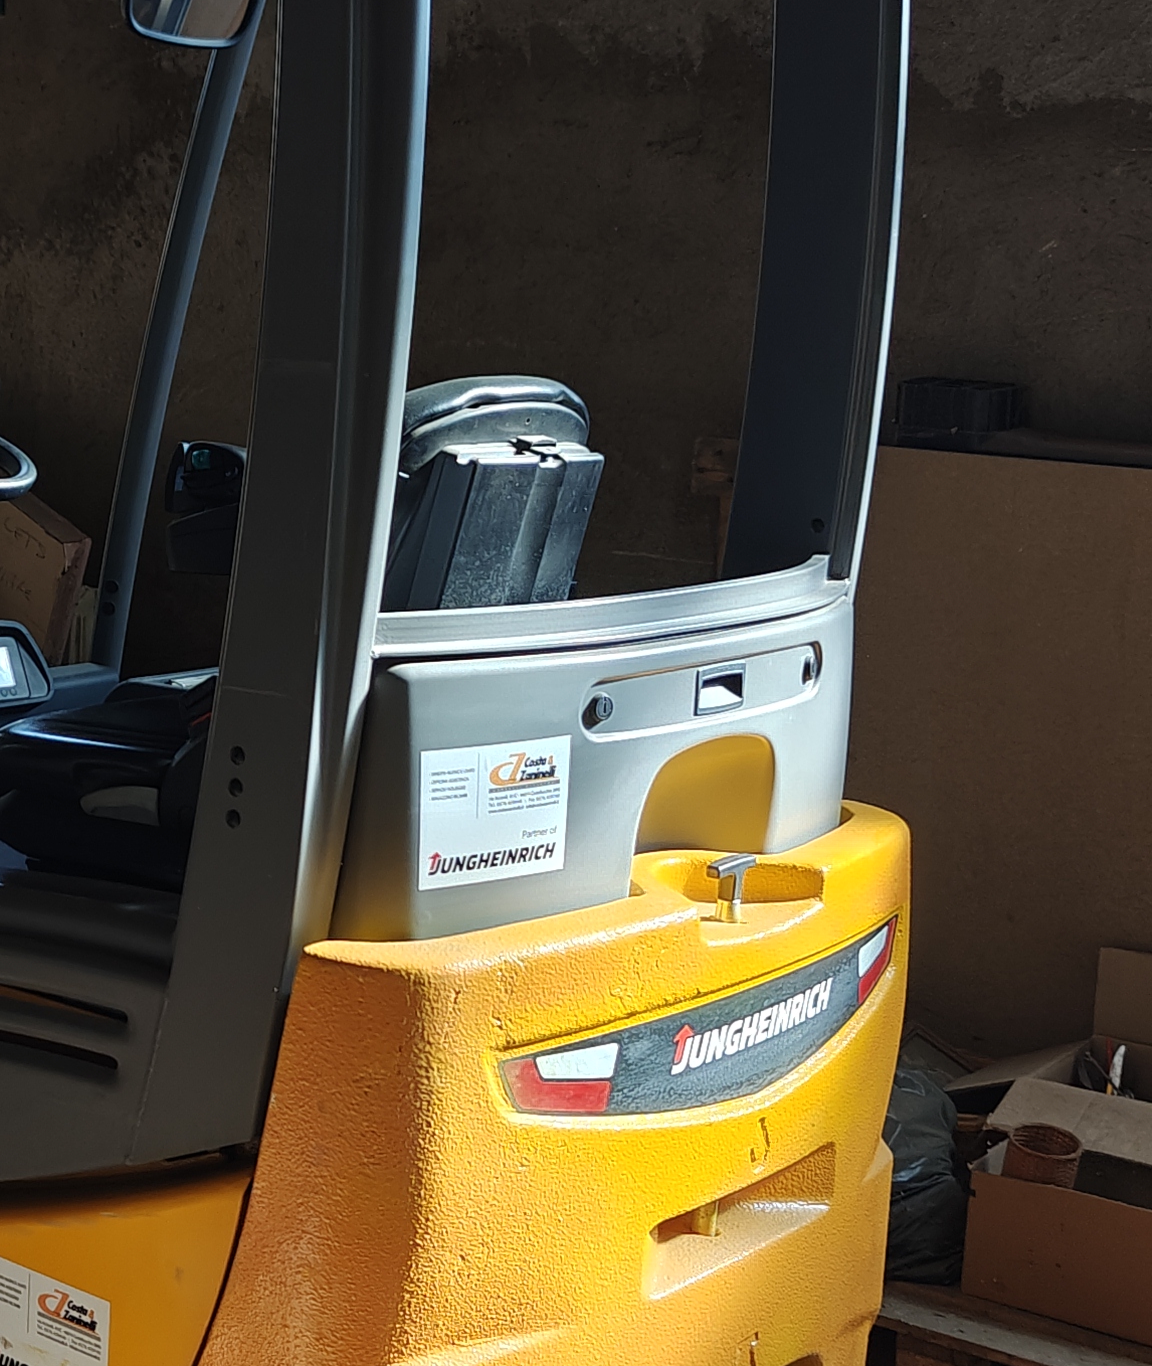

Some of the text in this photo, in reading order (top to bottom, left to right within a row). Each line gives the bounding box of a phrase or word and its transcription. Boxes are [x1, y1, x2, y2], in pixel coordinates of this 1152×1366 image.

[524, 756, 547, 768] Costa
[522, 828, 548, 839] Partner
[428, 842, 556, 876] JUNGHEINRICH
[670, 977, 834, 1076] JUNGHEINRICH
[67, 1300, 88, 1316] Costa
